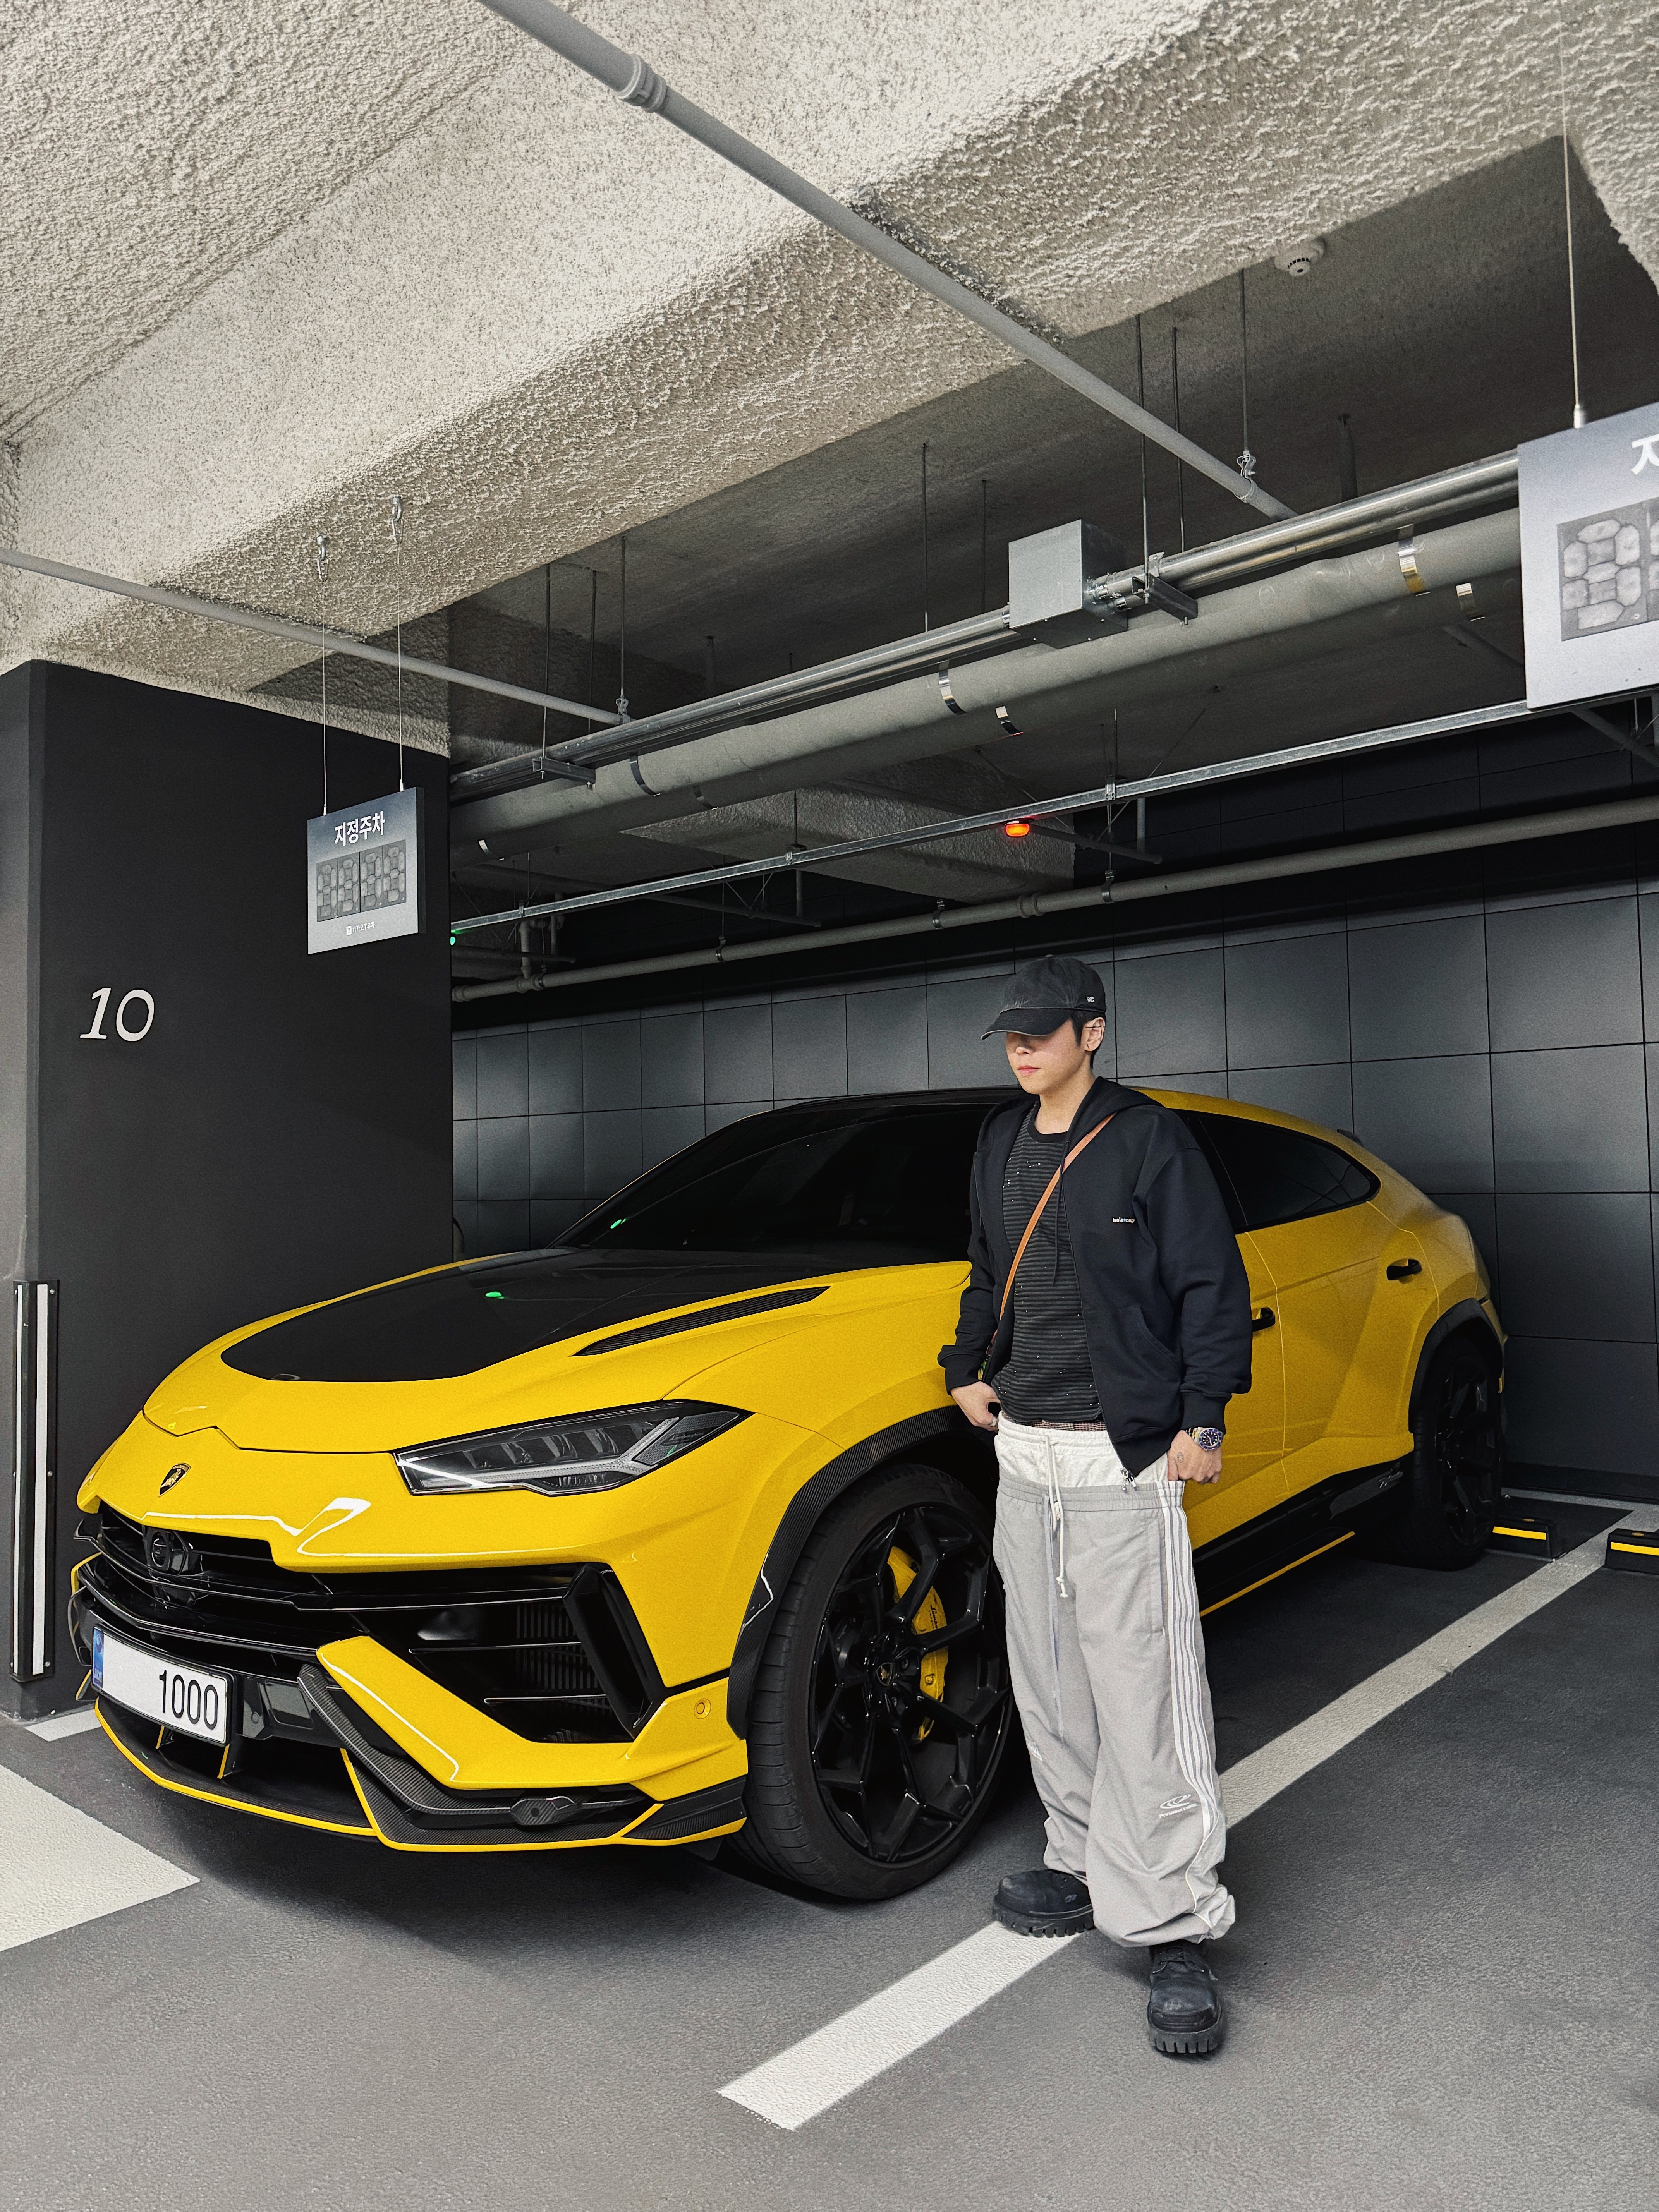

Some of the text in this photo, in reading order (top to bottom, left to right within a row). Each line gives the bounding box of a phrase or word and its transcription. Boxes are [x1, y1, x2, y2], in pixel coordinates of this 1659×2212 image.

[335, 810, 385, 846] 지정주차
[80, 988, 155, 1042] 10
[159, 1670, 218, 1730] 1000
